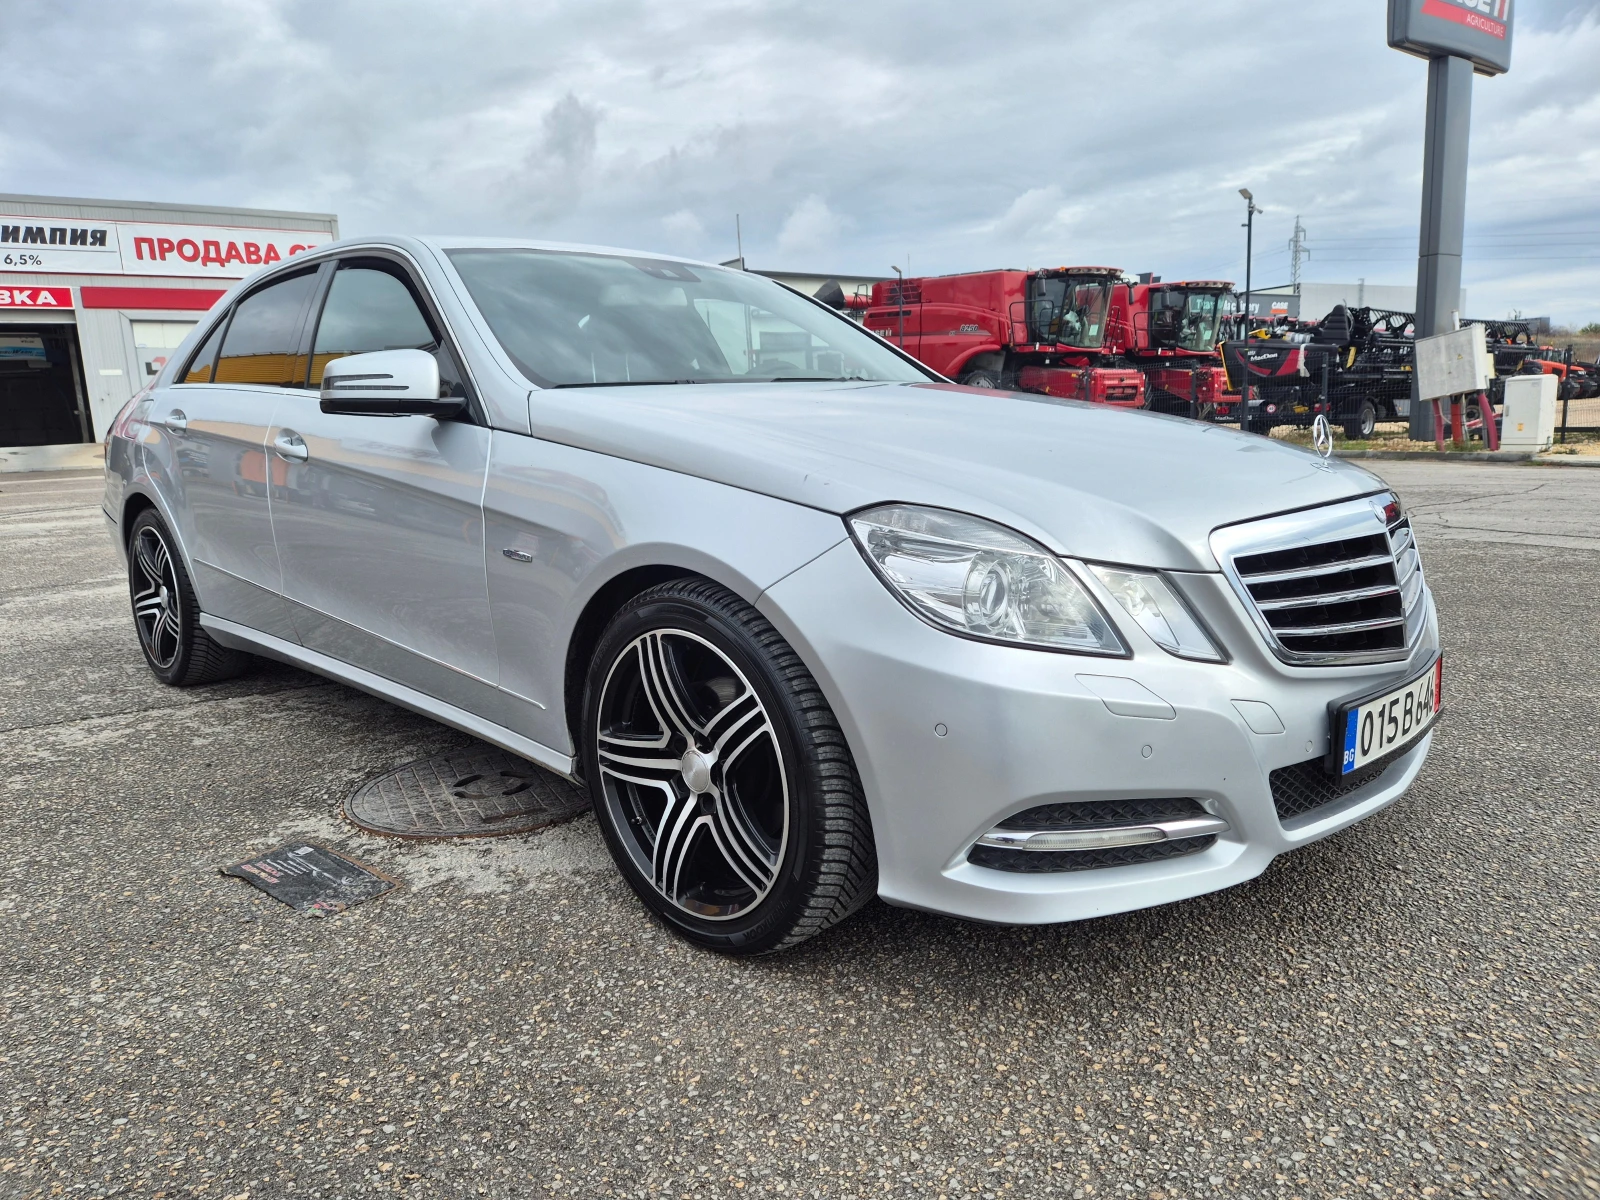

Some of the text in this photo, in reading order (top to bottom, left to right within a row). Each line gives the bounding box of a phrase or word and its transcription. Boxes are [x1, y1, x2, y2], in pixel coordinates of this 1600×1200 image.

[1466, 13, 1504, 37] AGRICULTURE
[0, 225, 107, 247] ИМПИЯ
[4, 253, 42, 266] 6,5%
[134, 237, 282, 267] ПРОДАВА
[1271, 301, 1289, 310] CASE
[1250, 353, 1278, 362] MacDon
[1343, 748, 1355, 765] BG
